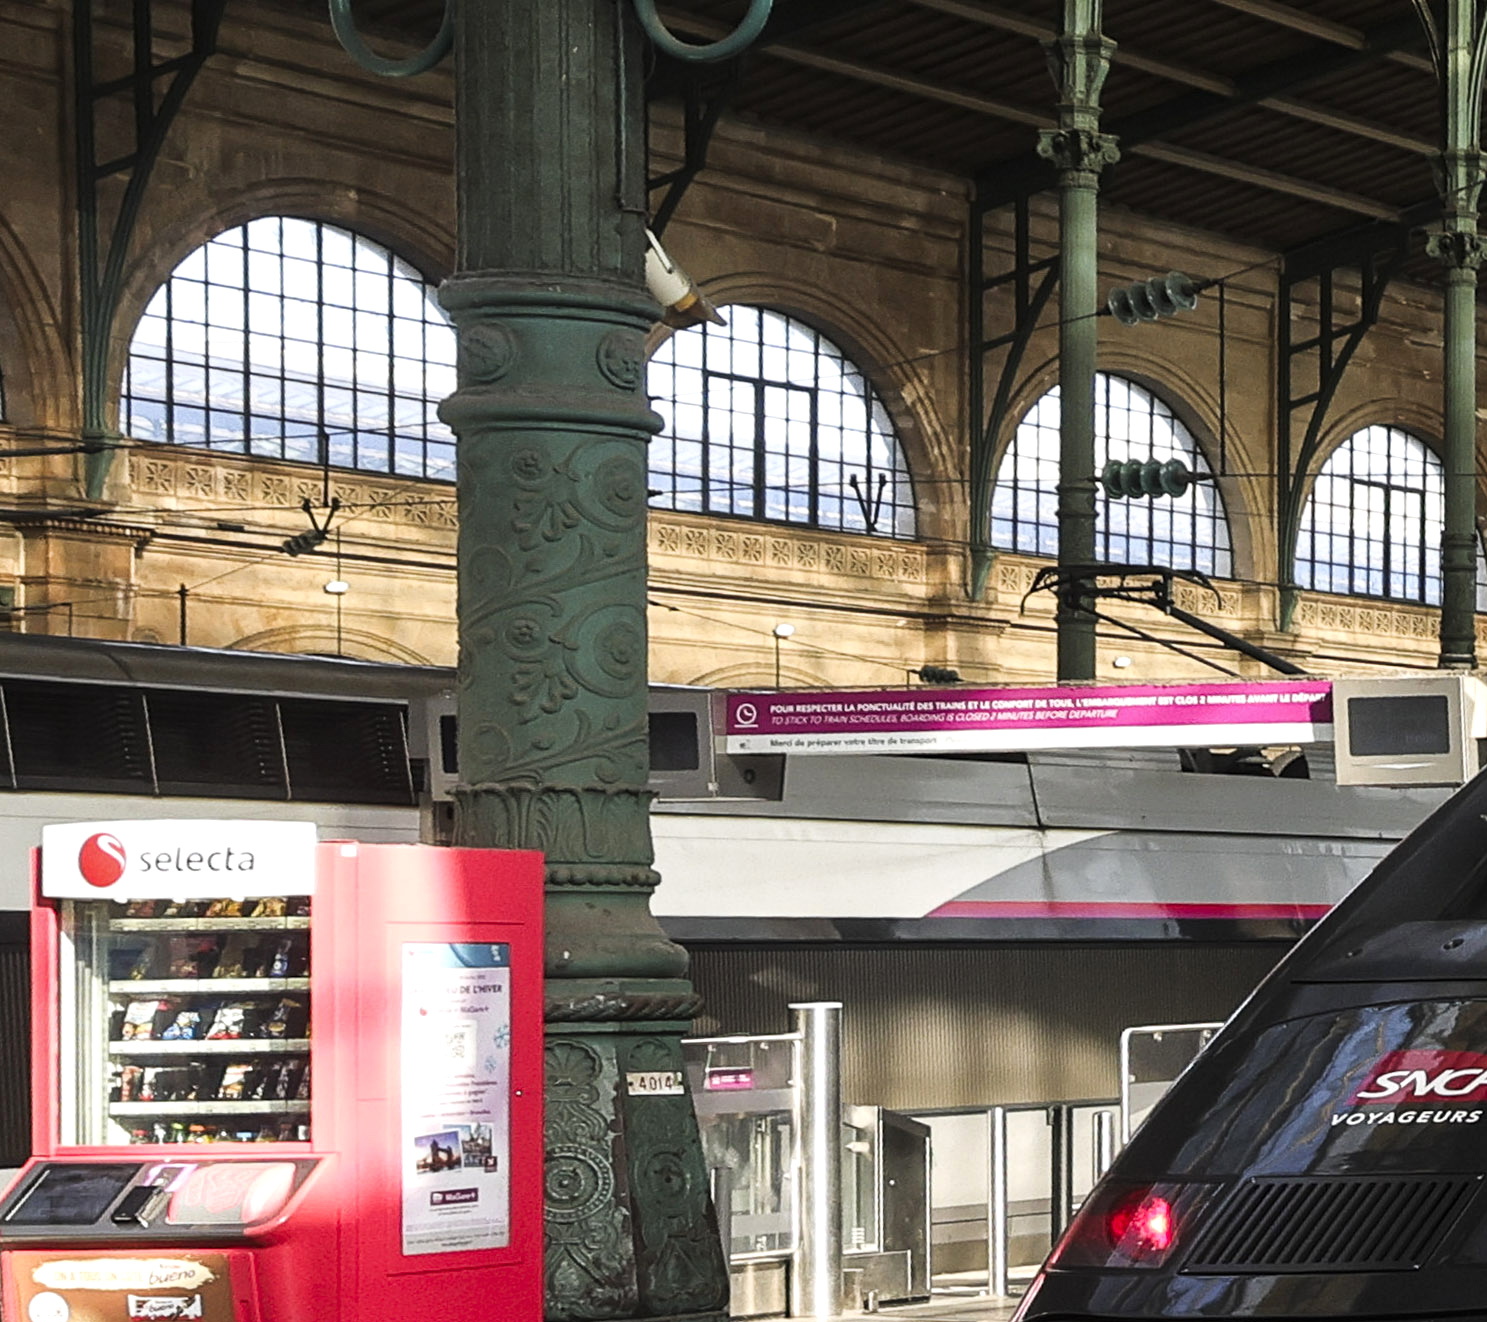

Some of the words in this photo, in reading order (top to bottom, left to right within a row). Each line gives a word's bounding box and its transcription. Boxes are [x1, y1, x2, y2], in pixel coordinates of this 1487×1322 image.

[770, 705, 794, 713] POUR
[796, 704, 842, 712] RESPECTER
[844, 703, 855, 711] LA
[858, 701, 914, 711] PONCTUALITÉ
[917, 702, 934, 710] DES
[936, 702, 966, 710] TRAINS
[968, 701, 978, 710] ET
[980, 701, 990, 709] LE
[1036, 699, 1049, 708] DE
[771, 716, 784, 725] TO
[786, 716, 808, 724] STICK
[810, 715, 822, 724] TO
[824, 715, 848, 724] TRAIN
[900, 714, 945, 722] BOARDING
[1036, 710, 1067, 720] BEFORE
[140, 847, 256, 873] selecta
[460, 985, 470, 993] DE
[473, 984, 502, 993] L'HIVER
[639, 1076, 672, 1090] 4014
[1331, 1110, 1483, 1126] VOYAGEURS
[149, 1268, 195, 1286] bueno
